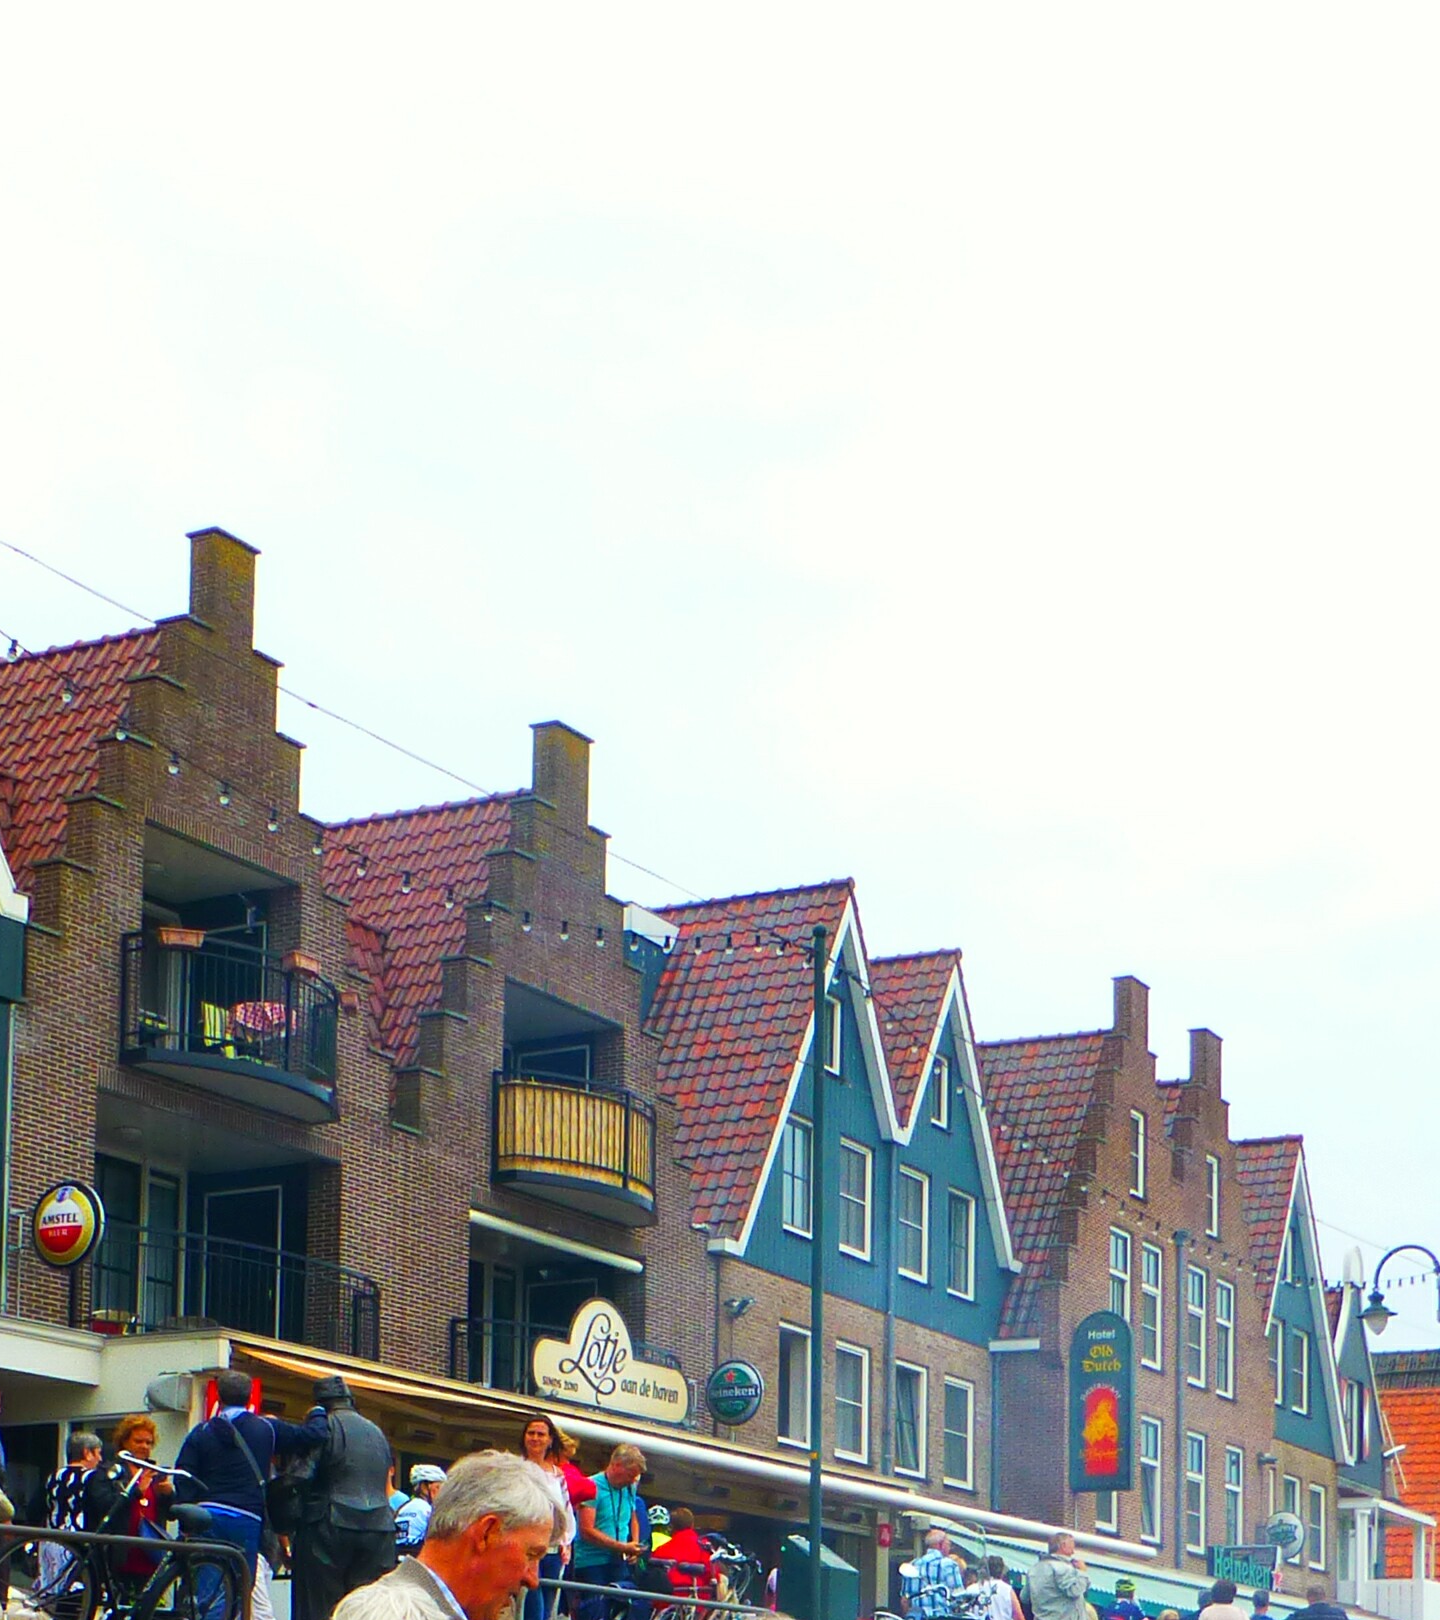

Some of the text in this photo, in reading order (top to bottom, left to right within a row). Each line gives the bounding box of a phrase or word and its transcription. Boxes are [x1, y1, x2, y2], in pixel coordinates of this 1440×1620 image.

[42, 1213, 78, 1225] AMSTEL
[1087, 1329, 1116, 1341] Hotel
[559, 1313, 627, 1404] Lotje
[1089, 1345, 1114, 1359] Old
[1082, 1360, 1122, 1373] Dutch
[621, 1377, 679, 1404] aan de haven
[1213, 1545, 1271, 1590] Heineken
